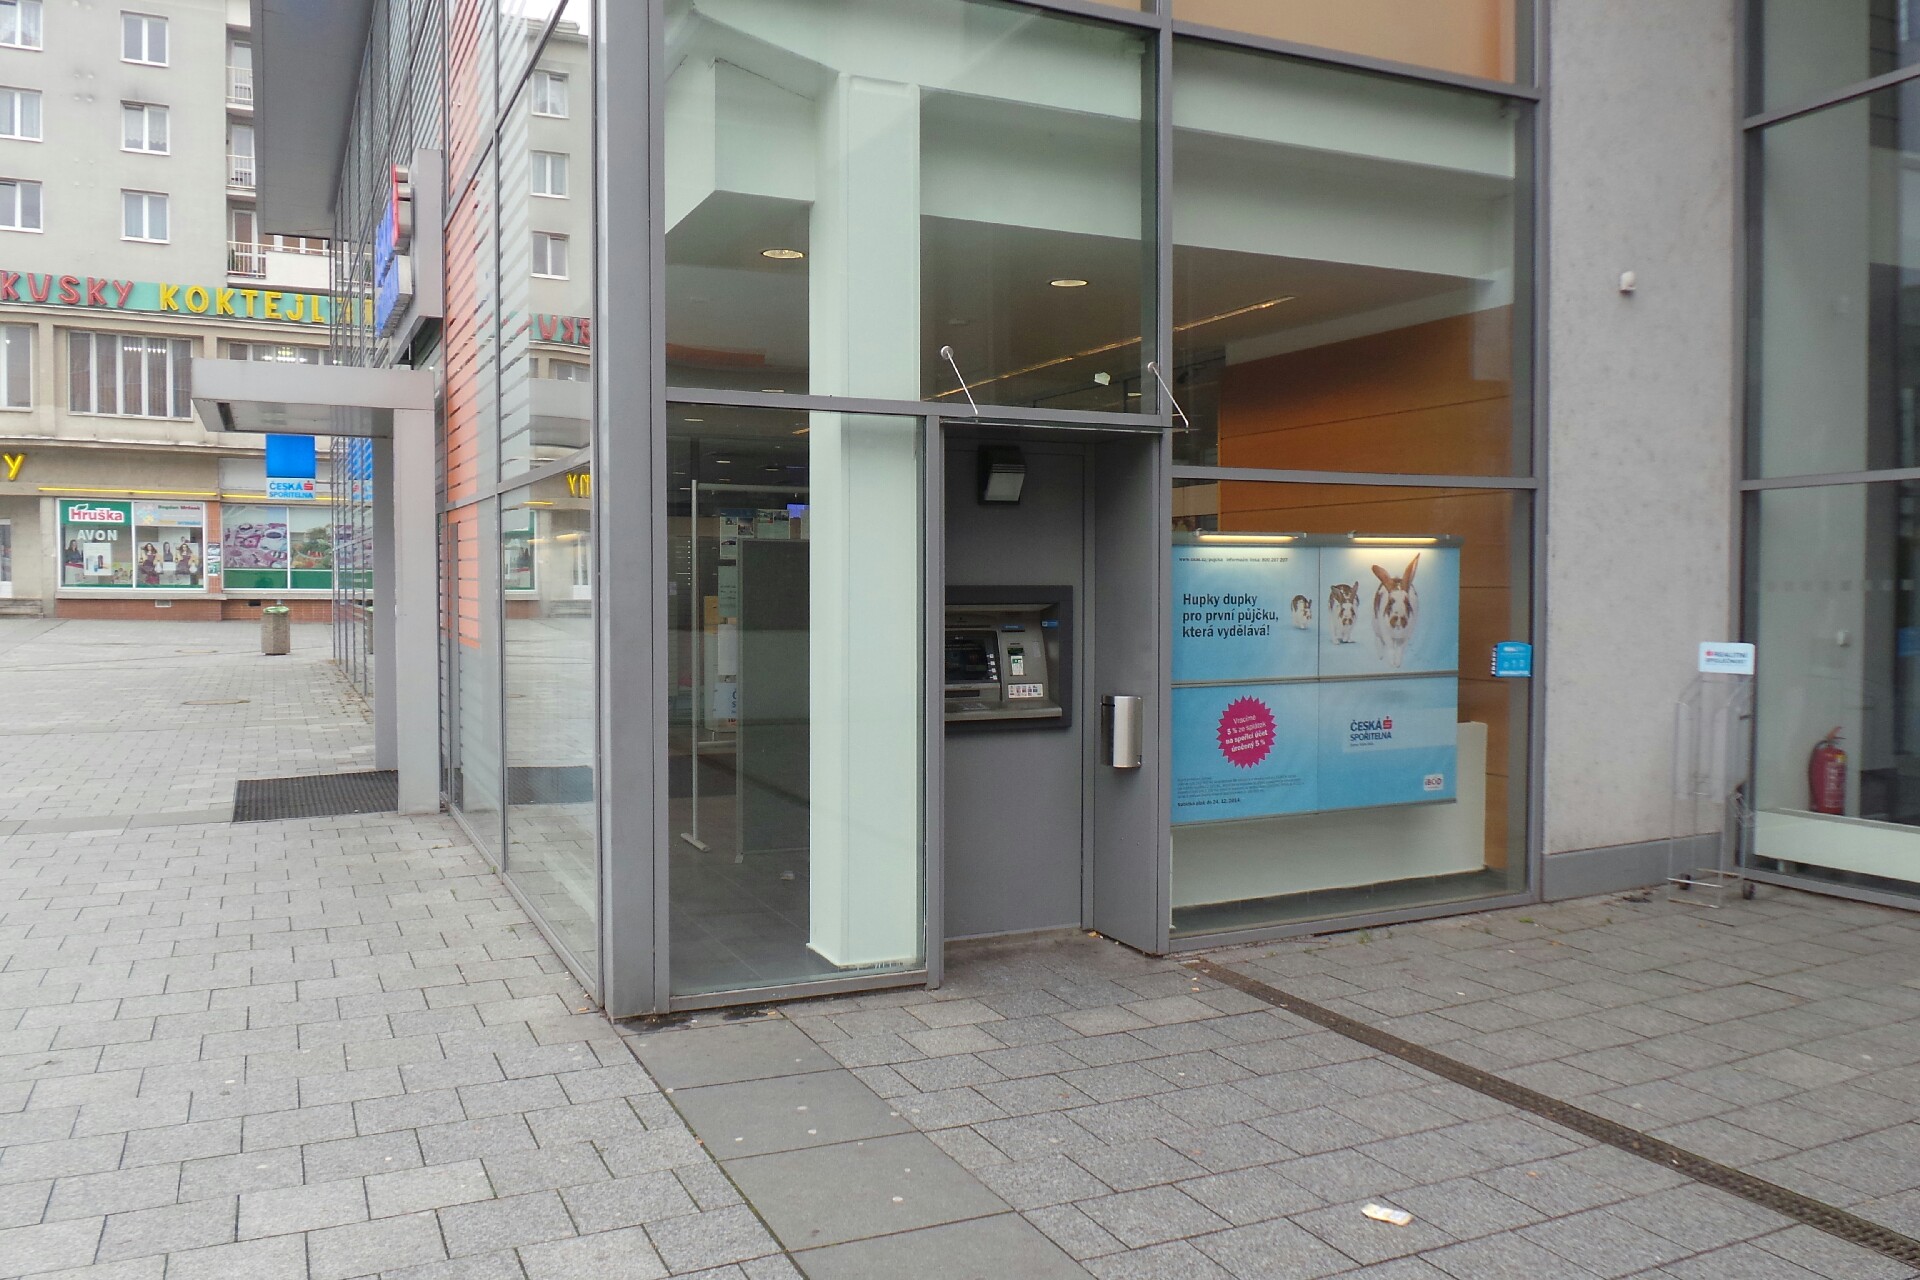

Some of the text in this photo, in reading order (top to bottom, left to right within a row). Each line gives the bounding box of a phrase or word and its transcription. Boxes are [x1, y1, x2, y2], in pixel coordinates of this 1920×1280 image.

[269, 481, 303, 490] ČESKÁ
[269, 490, 313, 499] SPOŘITELNA
[70, 506, 123, 521] Hruška
[77, 529, 118, 541] AVON
[1183, 593, 1258, 607] Hupky dupky
[1182, 608, 1279, 624] pro první půjčku,
[1182, 624, 1270, 639] která vydělává!
[1350, 718, 1383, 732] ČESKÁ
[1350, 731, 1392, 742] SPOŘITELNA
